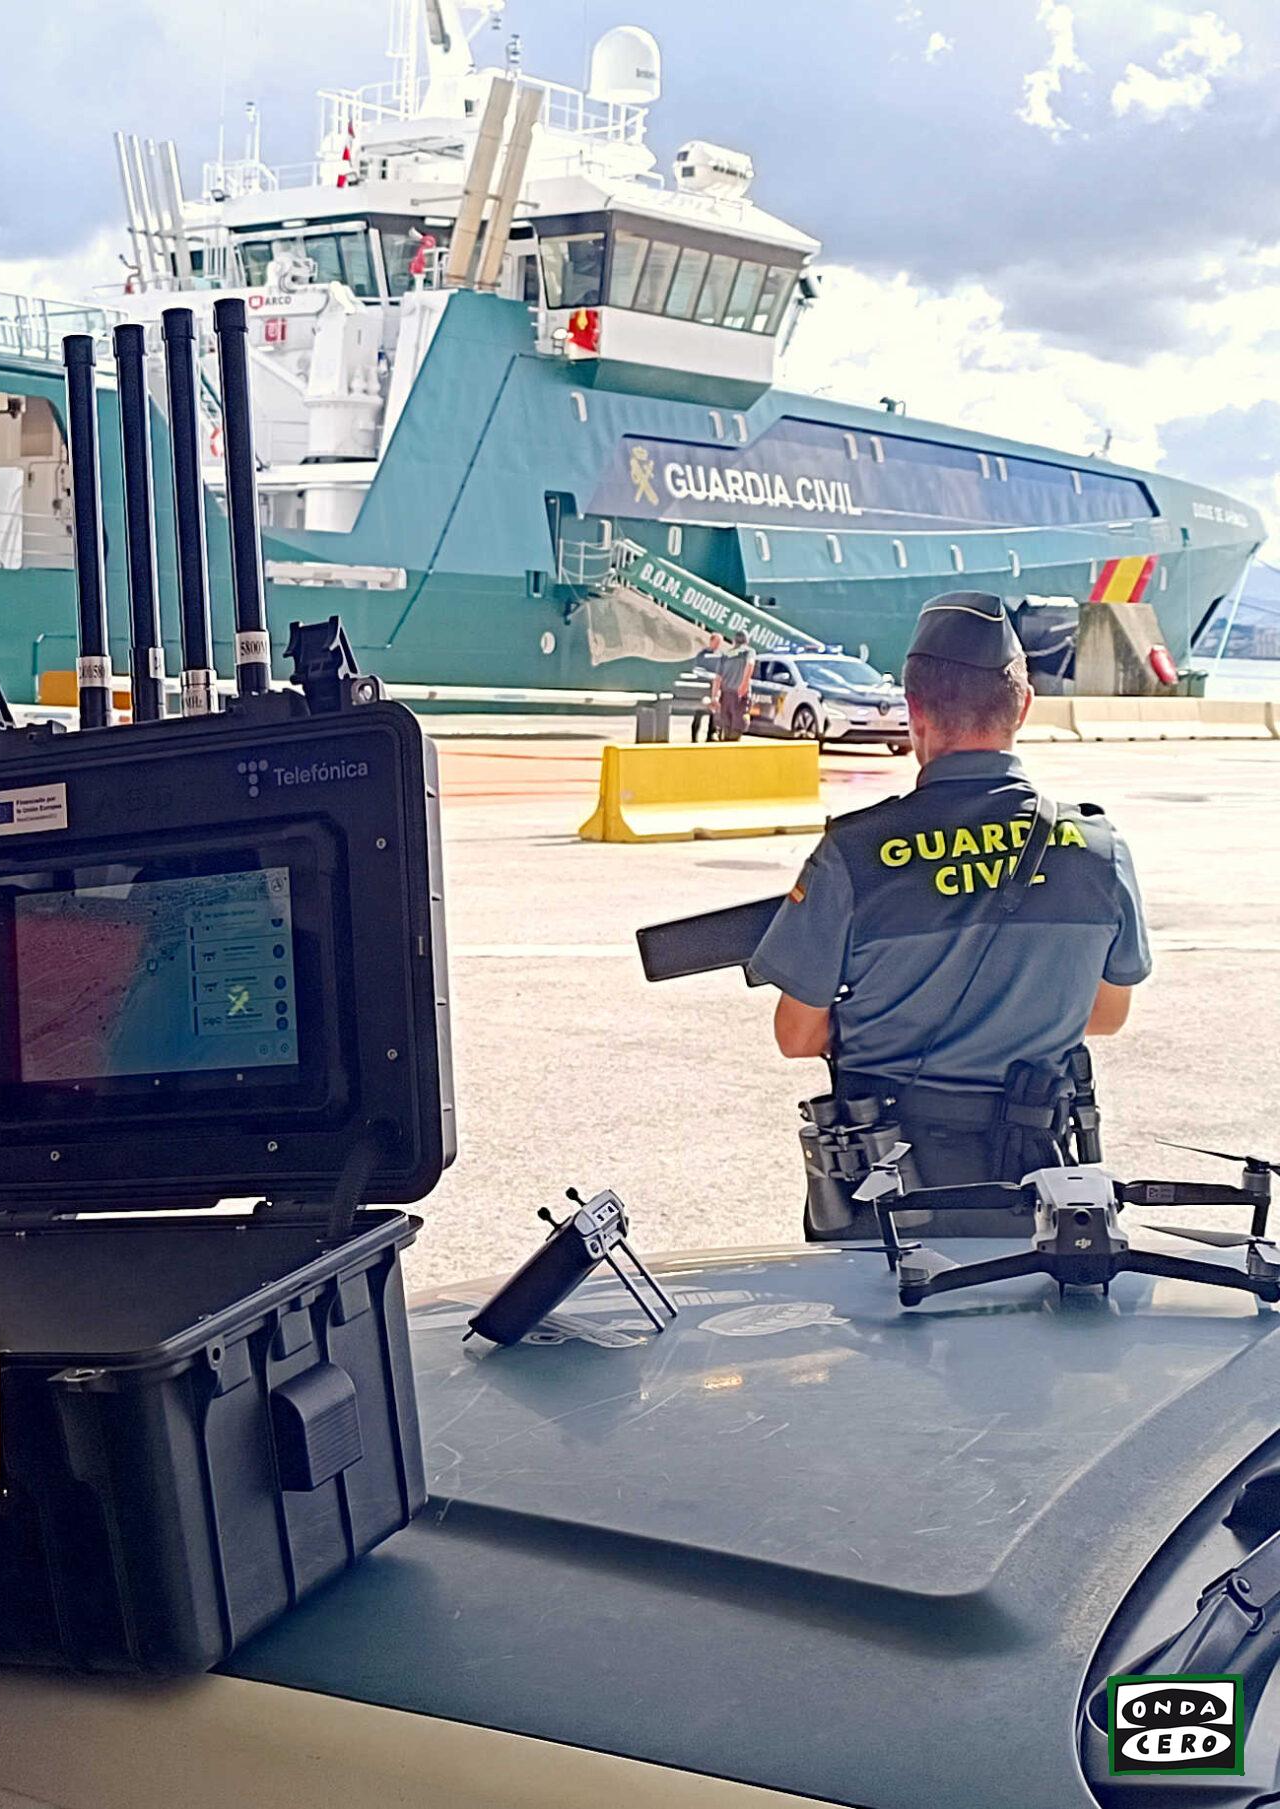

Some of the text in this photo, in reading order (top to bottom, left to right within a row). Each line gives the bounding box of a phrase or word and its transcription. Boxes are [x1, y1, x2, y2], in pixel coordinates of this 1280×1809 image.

[664, 462, 863, 516] GUARDIA CIVIL
[640, 562, 680, 599] B.O.M.
[682, 586, 731, 624] DUQUE
[728, 611, 751, 634] DE
[273, 760, 369, 786] Telefónica
[934, 855, 1046, 896] CIV
